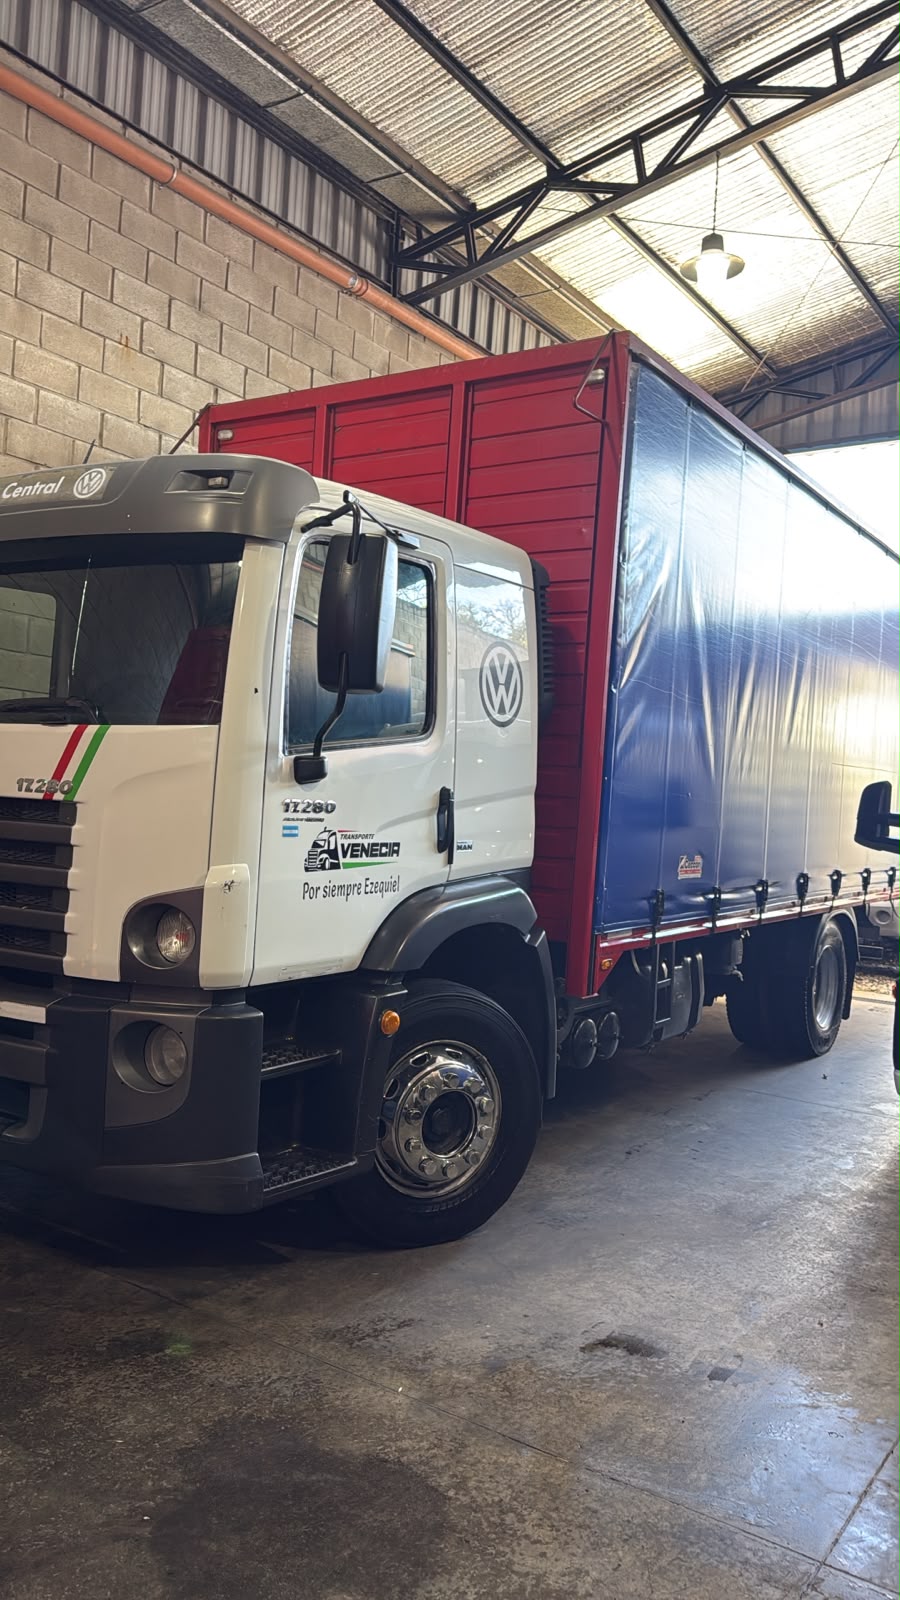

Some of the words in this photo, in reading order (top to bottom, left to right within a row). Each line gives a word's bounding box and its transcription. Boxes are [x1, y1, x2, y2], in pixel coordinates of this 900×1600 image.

[2, 476, 65, 499] Central
[340, 842, 400, 858] VENECIA
[302, 881, 321, 900] Por
[322, 880, 362, 902] siempre
[364, 875, 400, 899] Ezequiel
